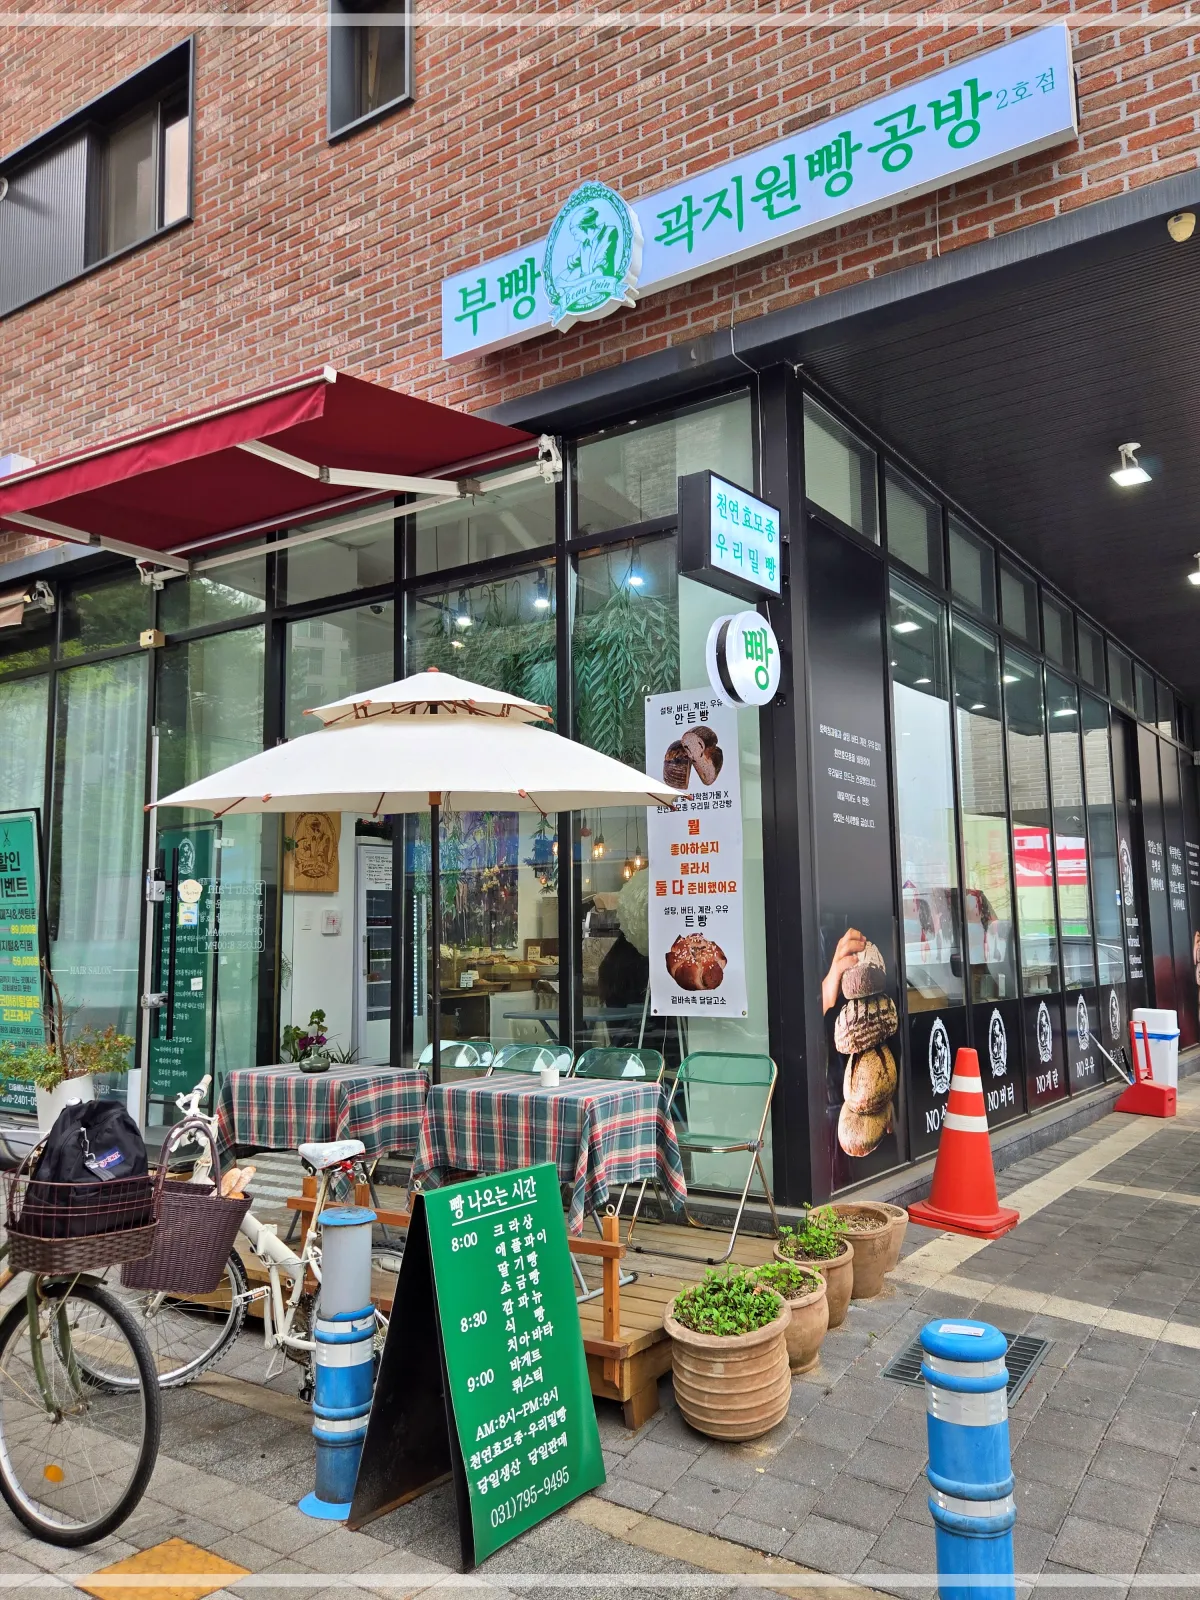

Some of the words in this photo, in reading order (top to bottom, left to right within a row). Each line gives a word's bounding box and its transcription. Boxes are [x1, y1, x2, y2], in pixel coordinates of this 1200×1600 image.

[994, 66, 1057, 111] 2호점
[453, 257, 541, 335] 부빵
[565, 285, 587, 304] Beau
[589, 279, 611, 292] Pain
[715, 492, 776, 543] 천연효모종
[741, 627, 774, 691] 빵
[674, 713, 684, 725] 안
[687, 712, 696, 724] 든
[699, 710, 709, 722] 빵
[690, 801, 710, 811] 우리밀
[712, 799, 733, 810] 건강빵
[687, 819, 700, 836] 뭘
[670, 841, 720, 856] 좋아하실지
[679, 861, 710, 876] 몰라서
[655, 880, 667, 897] 둘
[672, 879, 684, 896] 다
[687, 881, 738, 895] 준비했어요
[715, 904, 729, 914] 우유
[685, 915, 695, 928] 든
[697, 914, 708, 928] 빵
[69, 965, 87, 975] HAIR
[88, 965, 112, 975] SALON
[670, 995, 698, 1006] 겉바속촉
[699, 995, 727, 1006] 달달고소
[925, 1108, 940, 1134] NO
[448, 1194, 465, 1220] 빵
[467, 1185, 509, 1213] 나오는
[512, 1175, 537, 1201] 시간
[451, 1231, 478, 1252] 8:00
[460, 1310, 488, 1333] 8:30
[507, 1321, 554, 1353] 치아바타
[467, 1368, 495, 1393] 9:00
[509, 1348, 543, 1373] 바게트
[476, 1459, 521, 1495] 당일생산
[527, 1431, 569, 1467] 당일판매
[490, 1465, 570, 1529] 031)795-9495
